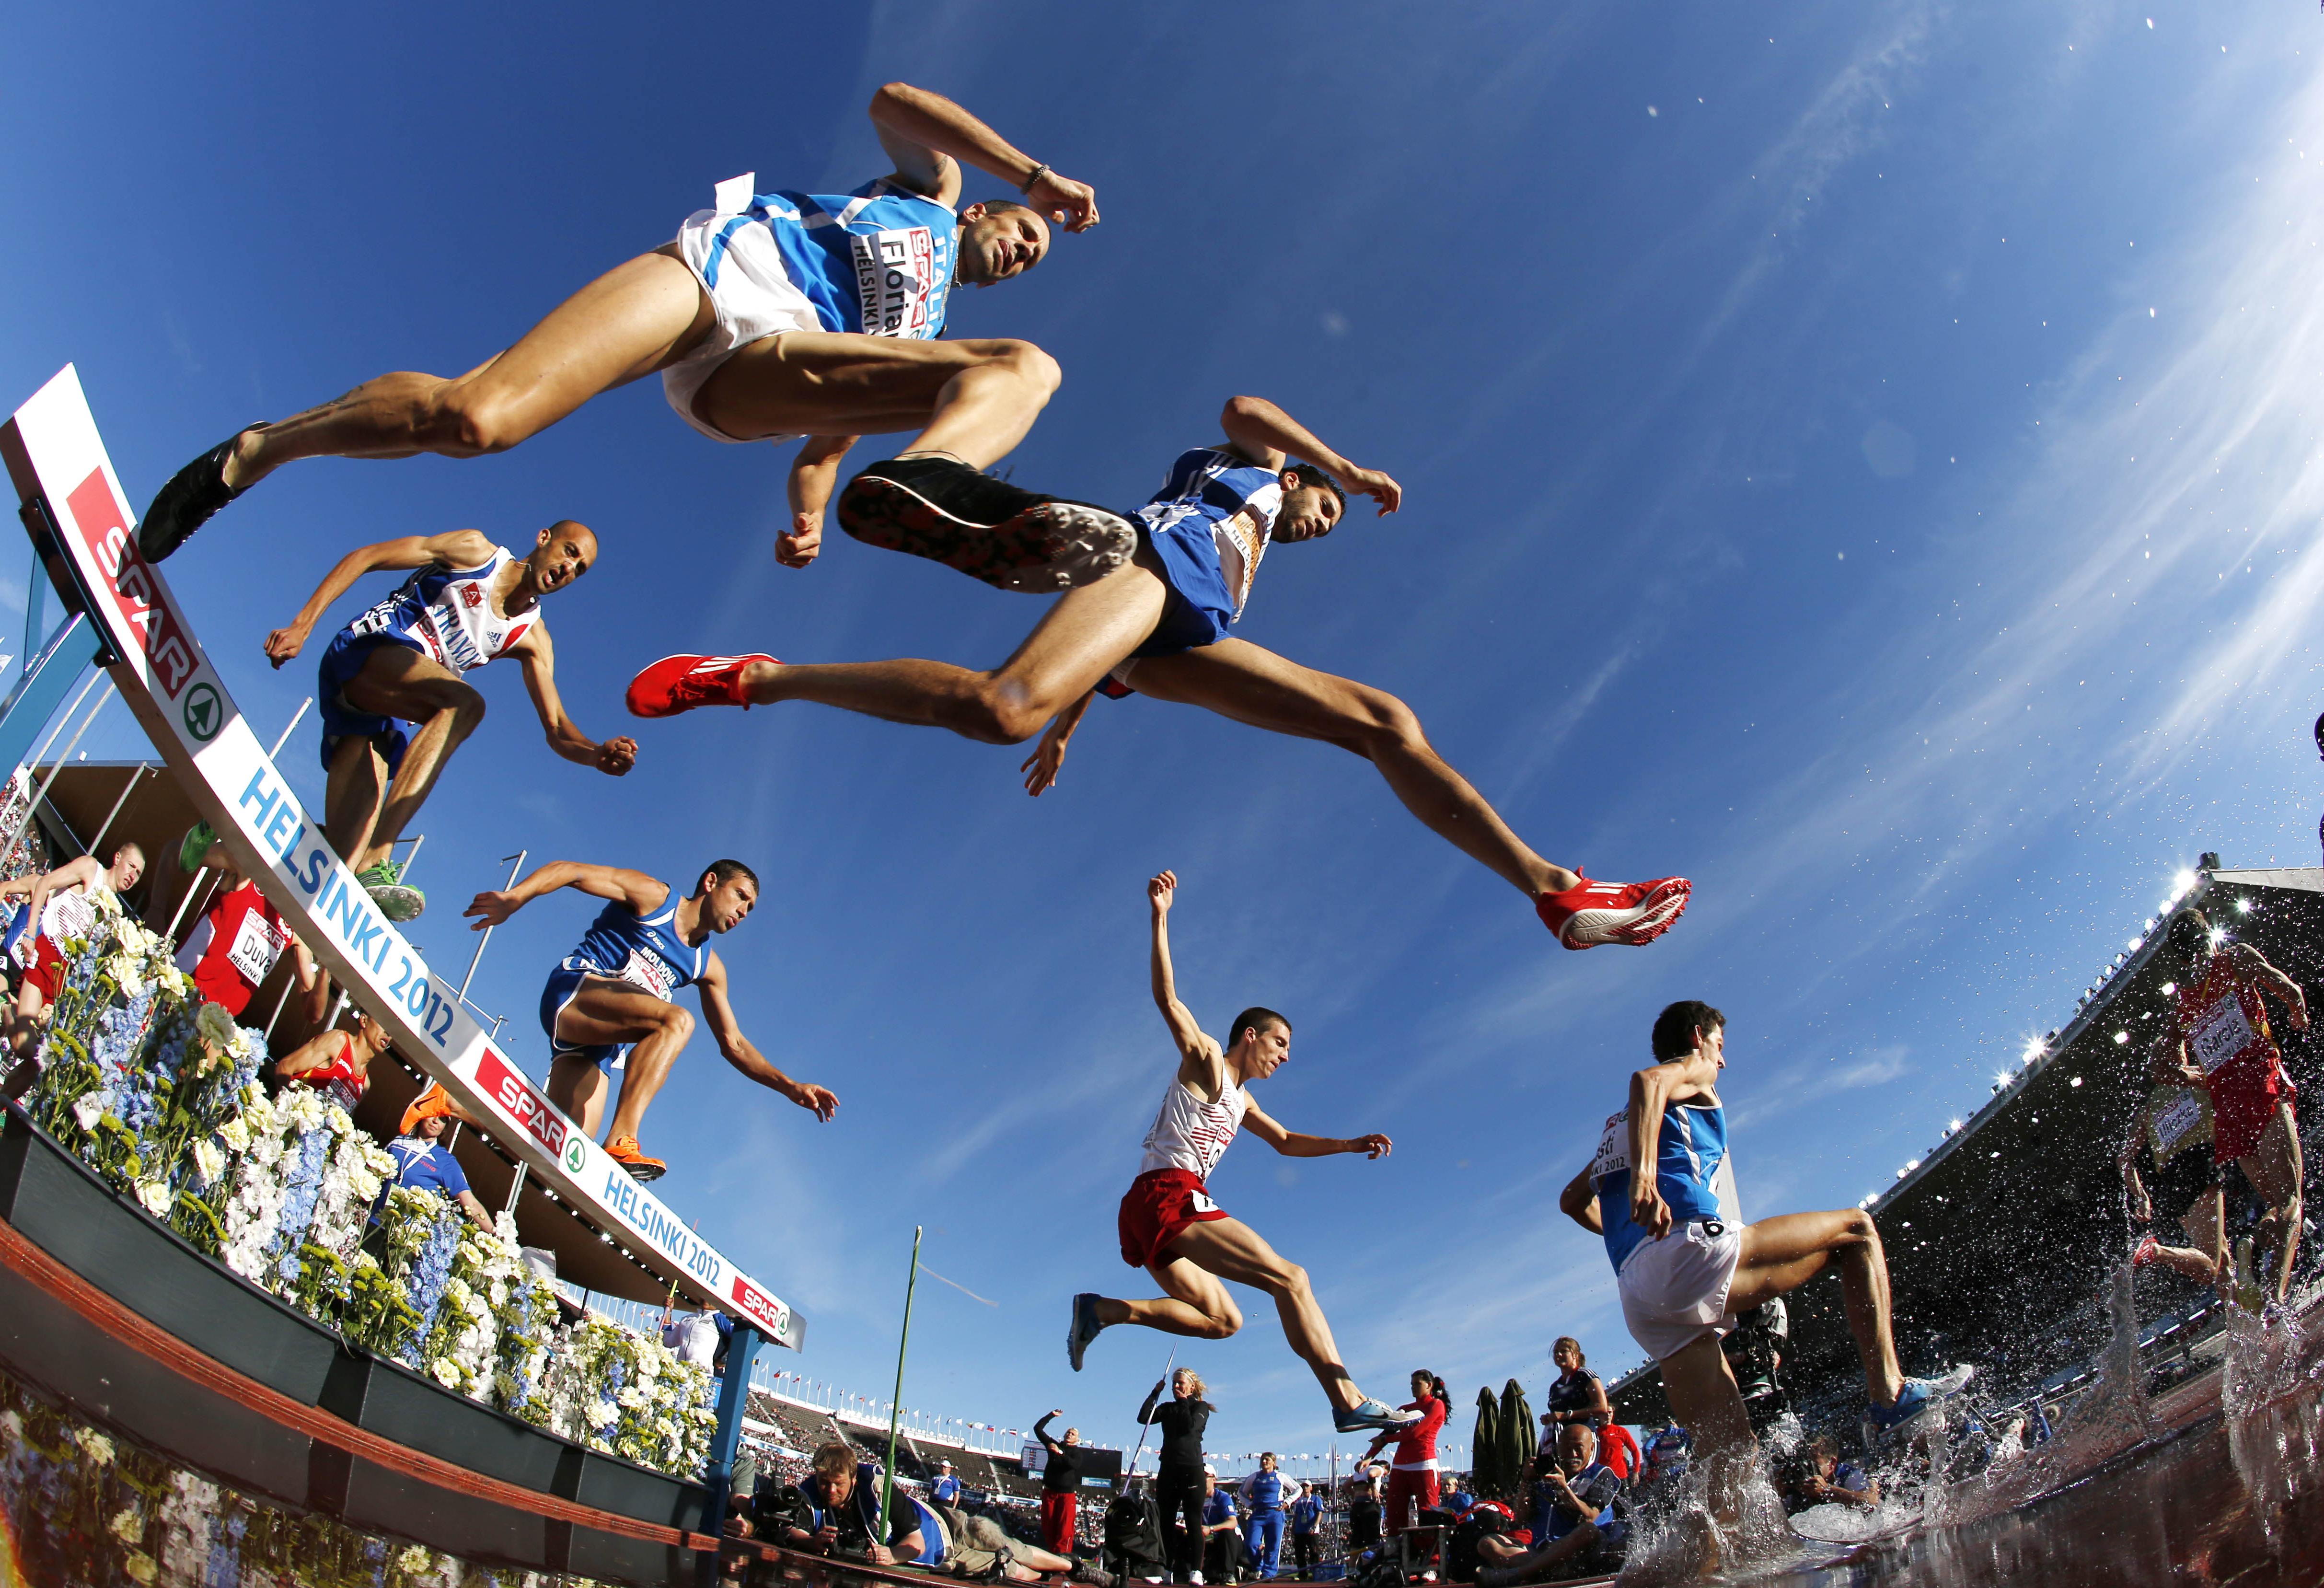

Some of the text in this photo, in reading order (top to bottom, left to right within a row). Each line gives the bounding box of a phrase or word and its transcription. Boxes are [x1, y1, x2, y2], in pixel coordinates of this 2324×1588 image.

[854, 245, 879, 326] HELSINKI
[912, 232, 930, 326] SPAR
[922, 236, 947, 339] ITALIA
[96, 525, 191, 690] SPAR
[434, 603, 482, 669] FRANCE
[239, 766, 454, 1048] HELSINKI 2012
[246, 912, 284, 949] SPAR
[652, 937, 665, 950] asics
[231, 953, 260, 983] HELSINKI
[640, 946, 677, 986] MOLDOVA
[2189, 1004, 2226, 1039] SPAR
[331, 1080, 353, 1107] SPAR
[498, 1075, 565, 1153] SPAR
[1605, 1156, 1625, 1171] 2012
[604, 1171, 720, 1287] HELSINKI 2012
[1702, 1219, 1724, 1237] 6
[743, 1288, 777, 1328] SPAR
